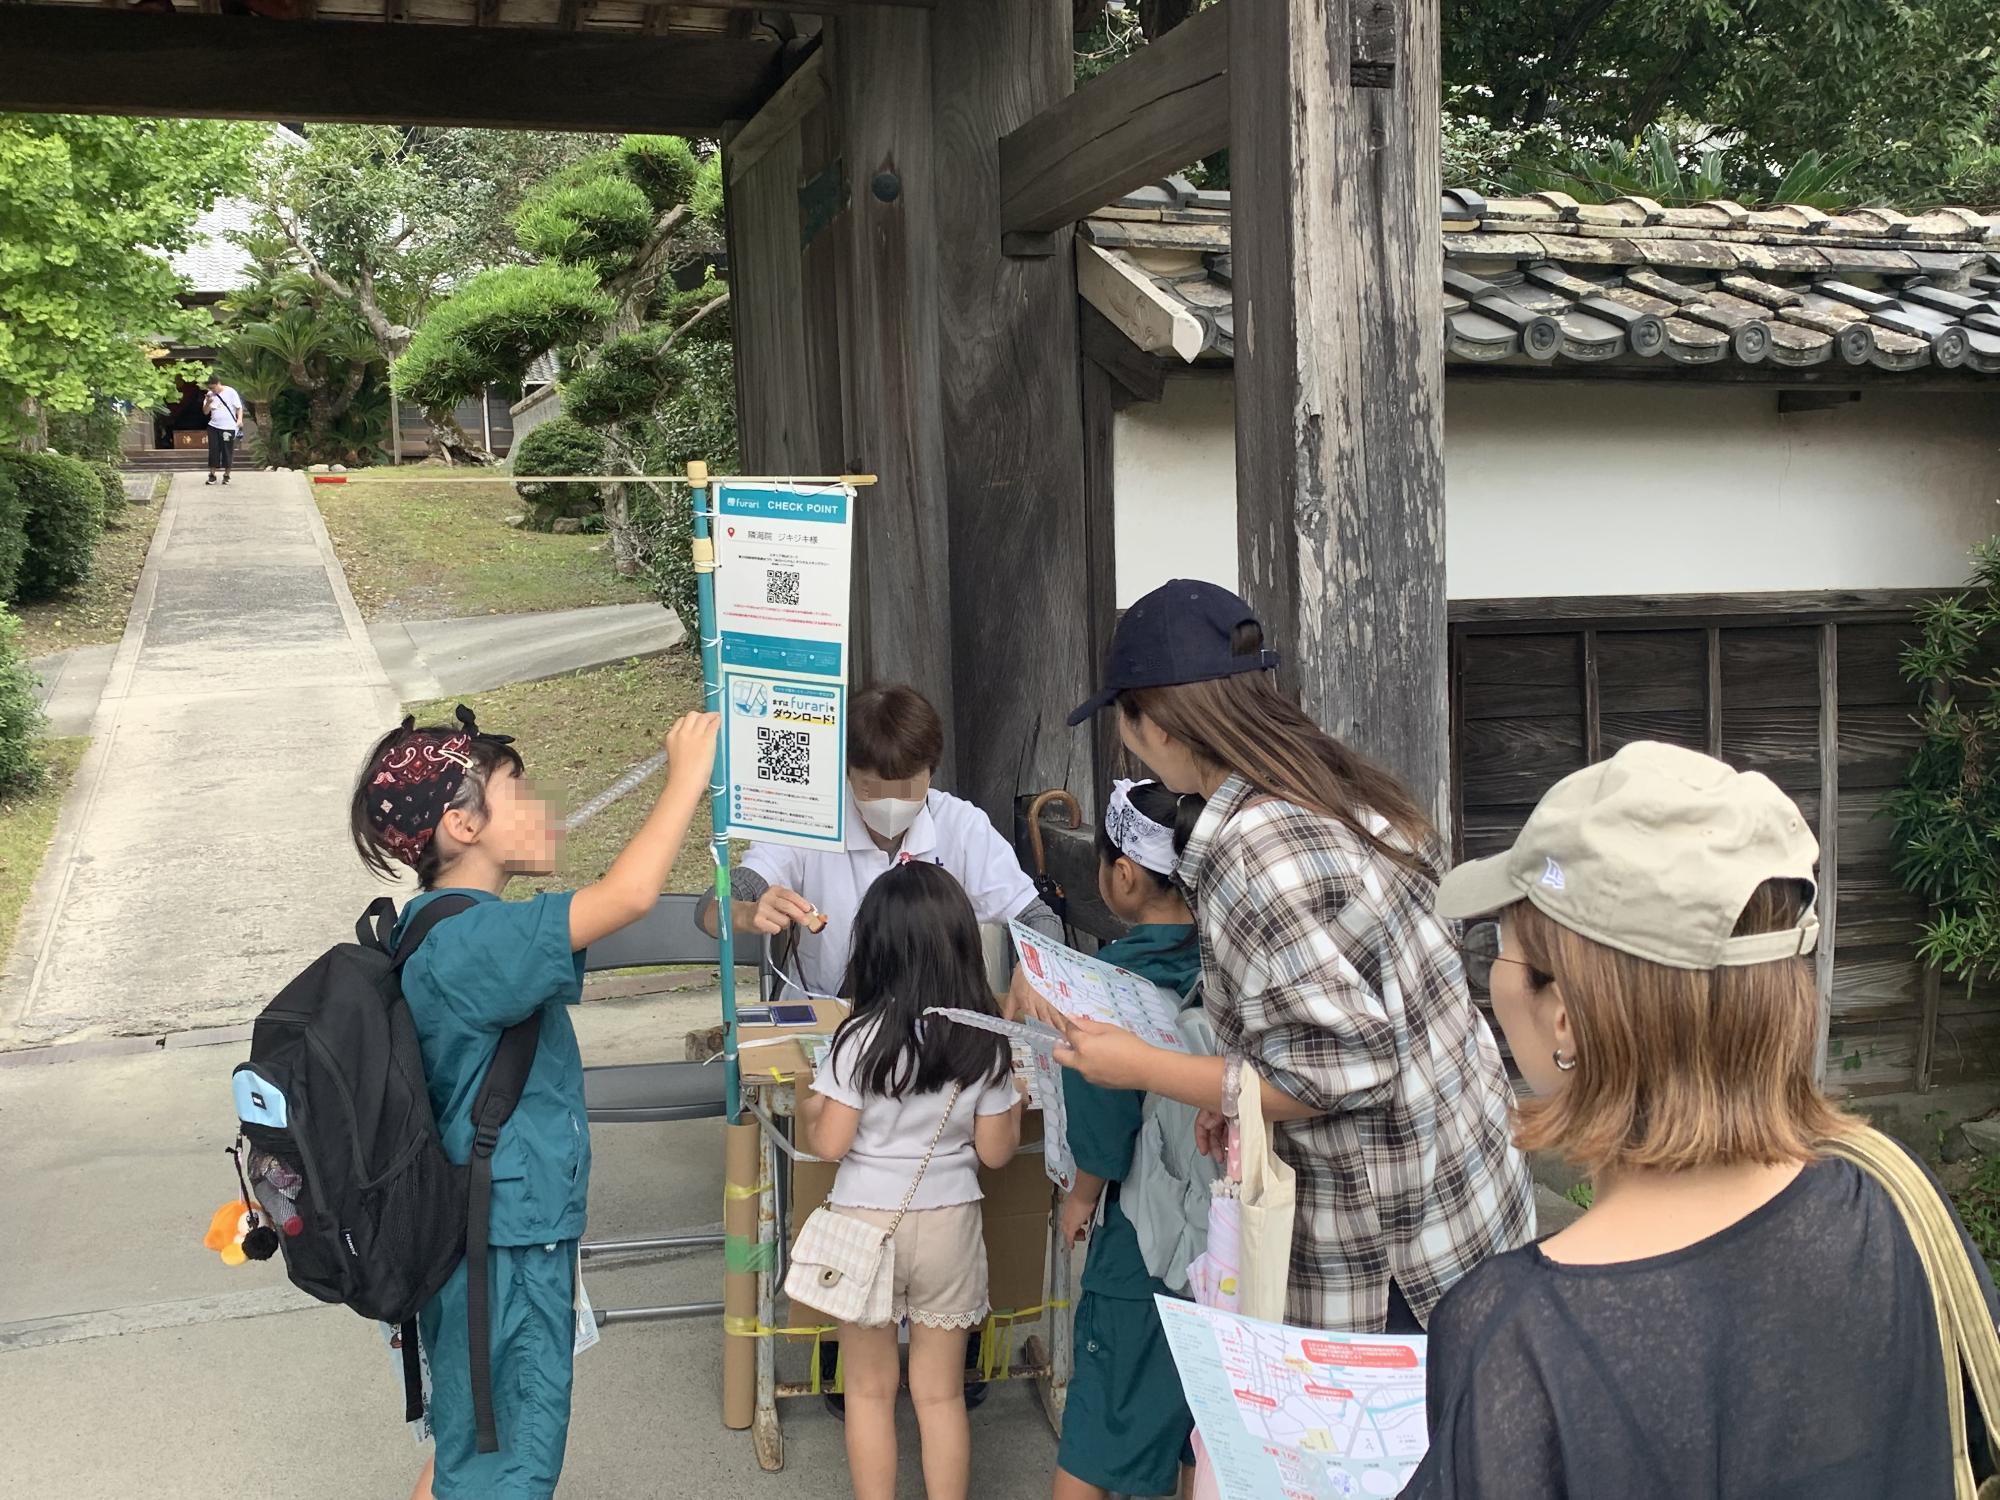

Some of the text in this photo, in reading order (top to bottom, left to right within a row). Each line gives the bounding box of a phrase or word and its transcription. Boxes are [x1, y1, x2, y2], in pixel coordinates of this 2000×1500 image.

[736, 498, 838, 514] furari CHECK POINT
[773, 708, 835, 725] ダウンロード!
